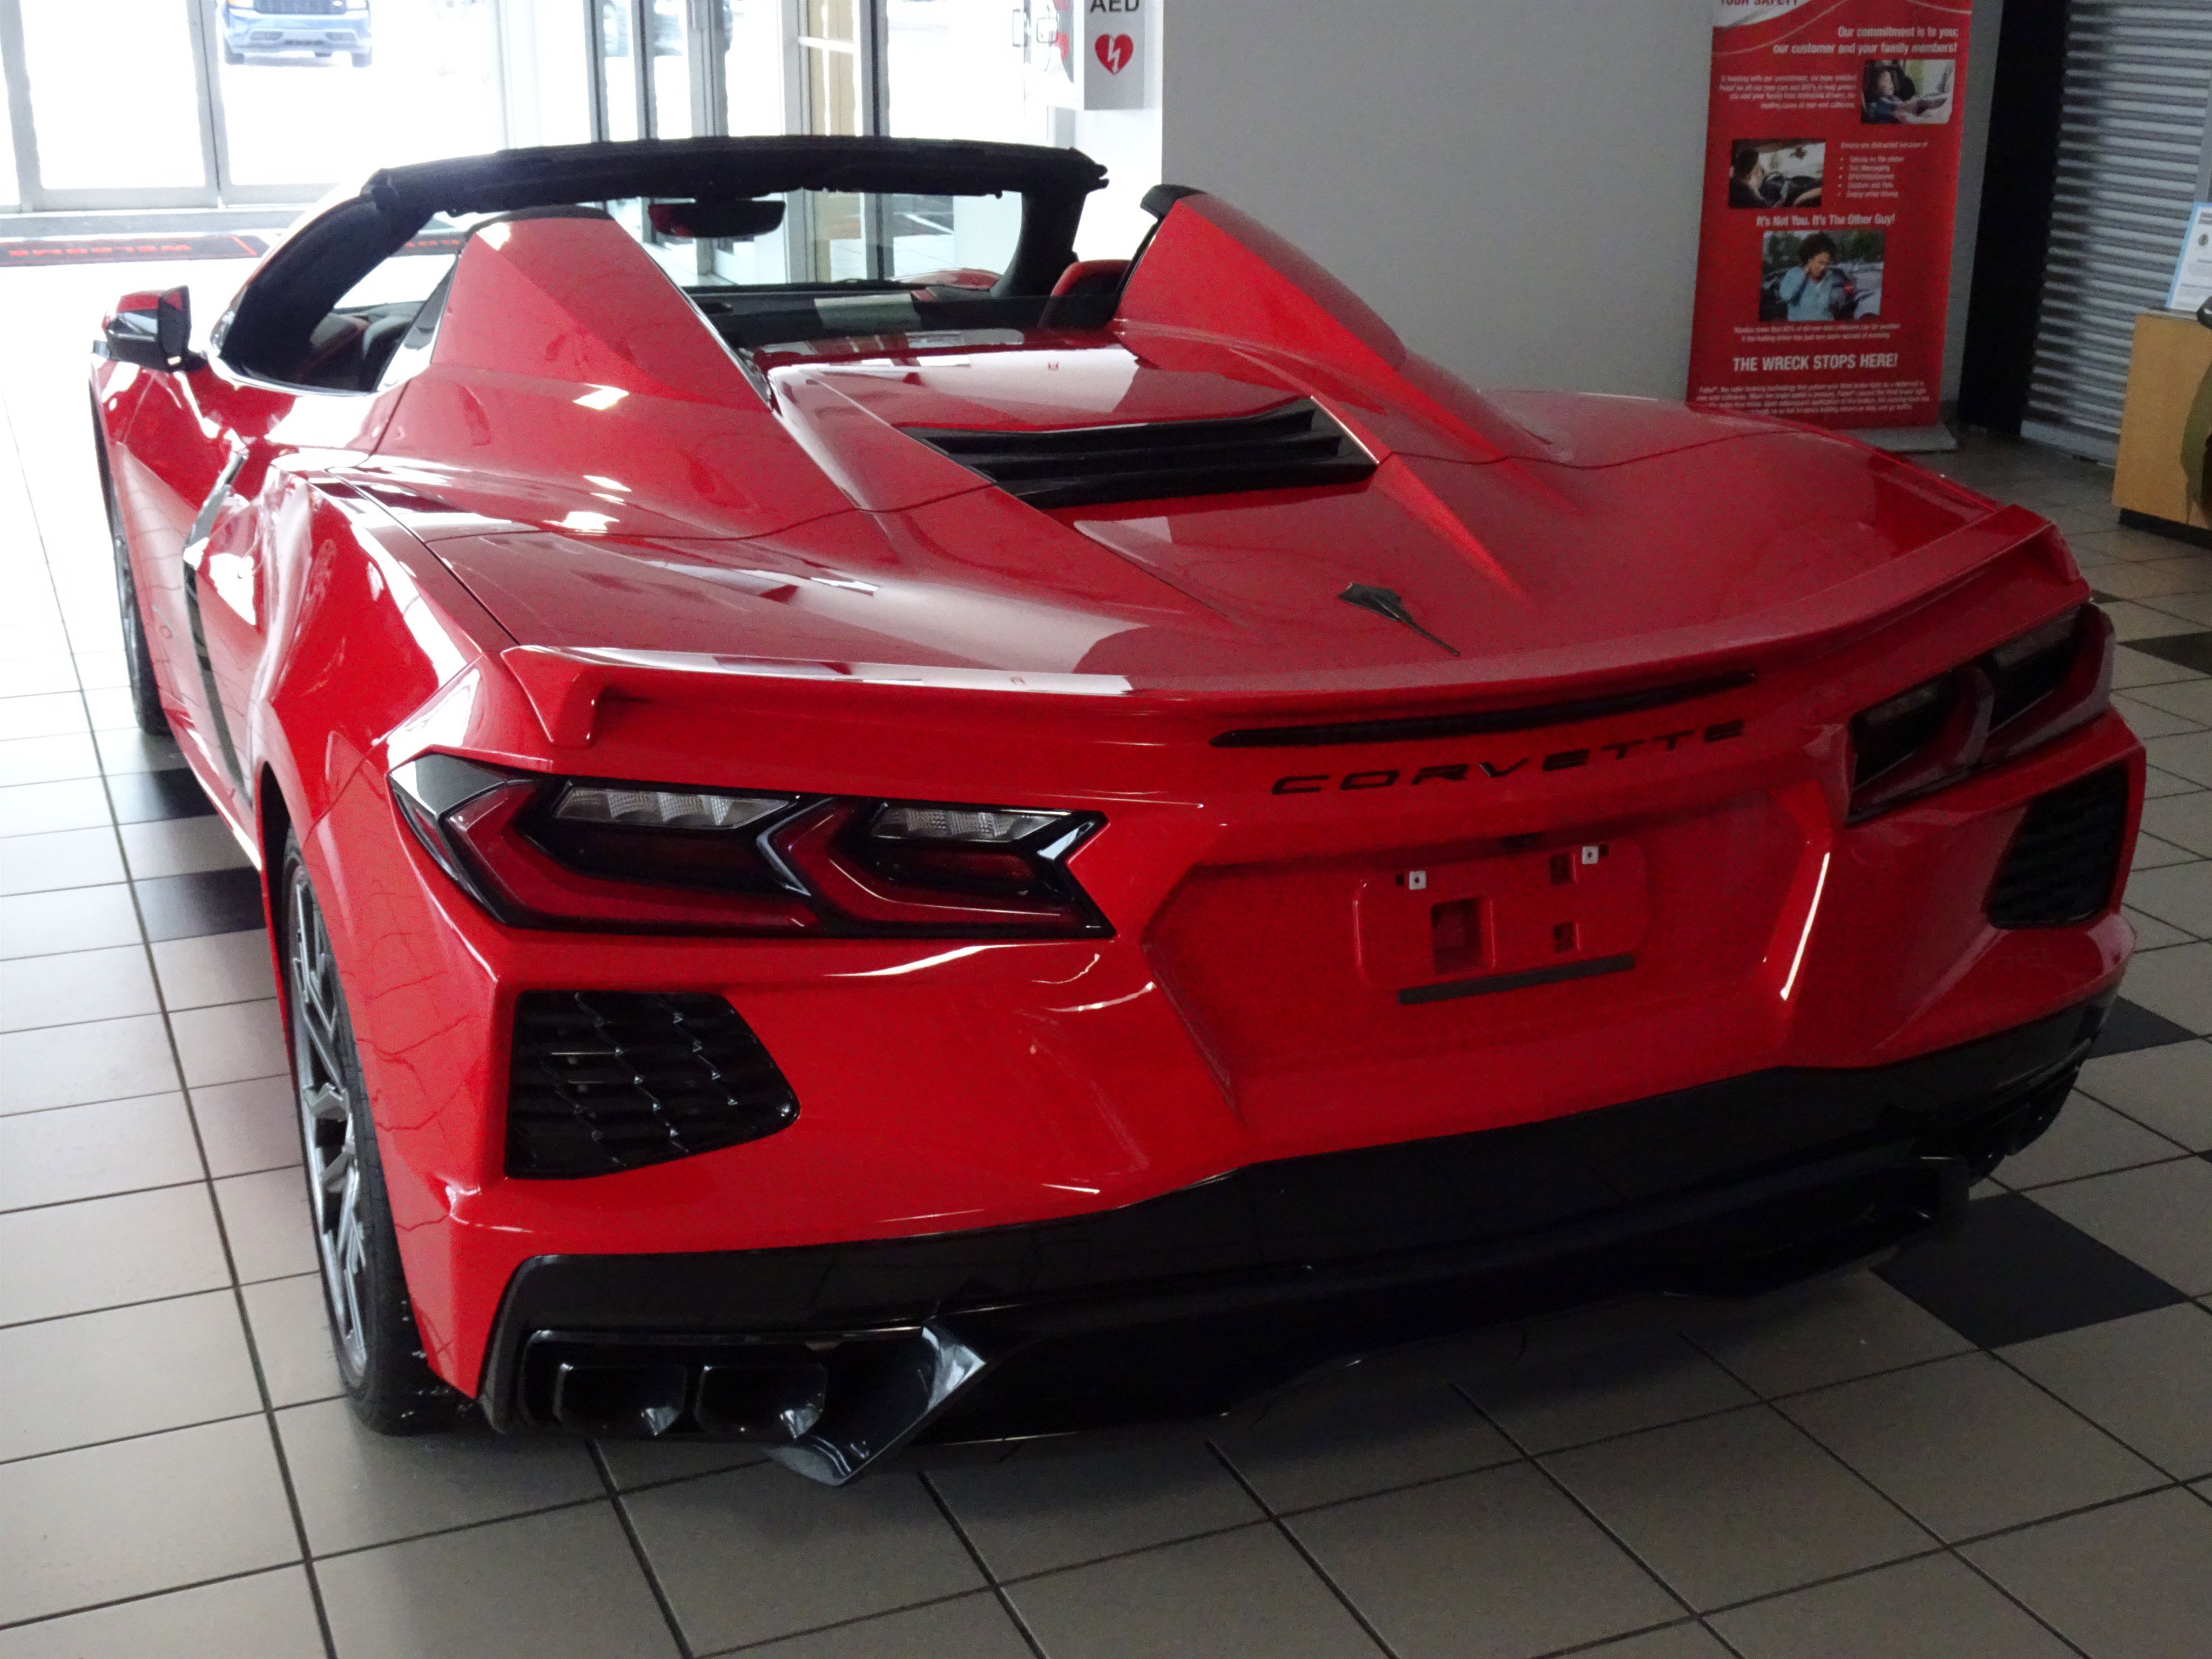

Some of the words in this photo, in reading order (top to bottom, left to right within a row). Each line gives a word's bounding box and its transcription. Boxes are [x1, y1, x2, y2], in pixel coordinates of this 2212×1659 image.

[1090, 0, 1139, 12] AED
[1838, 26, 1854, 38] Our
[1857, 26, 1914, 38] commitment
[1917, 27, 1925, 37] is
[1927, 26, 1937, 37] to
[1773, 44, 1789, 54] our
[1791, 43, 1835, 53] customer
[1838, 42, 1856, 53] and
[1858, 44, 1878, 56] your
[1880, 42, 1910, 55] family
[1756, 215, 1771, 226] It's
[1772, 215, 1789, 226] Not
[1812, 214, 1826, 226] It's
[1829, 213, 1845, 225] The
[1847, 213, 1872, 225] Other
[1874, 212, 1896, 226] Guy!
[1732, 357, 1758, 372] THE
[1762, 355, 1810, 371] WRECK
[1812, 354, 1856, 369] STOPS
[1859, 353, 1898, 368] HERE!
[1271, 719, 1745, 795] CORVETTE
